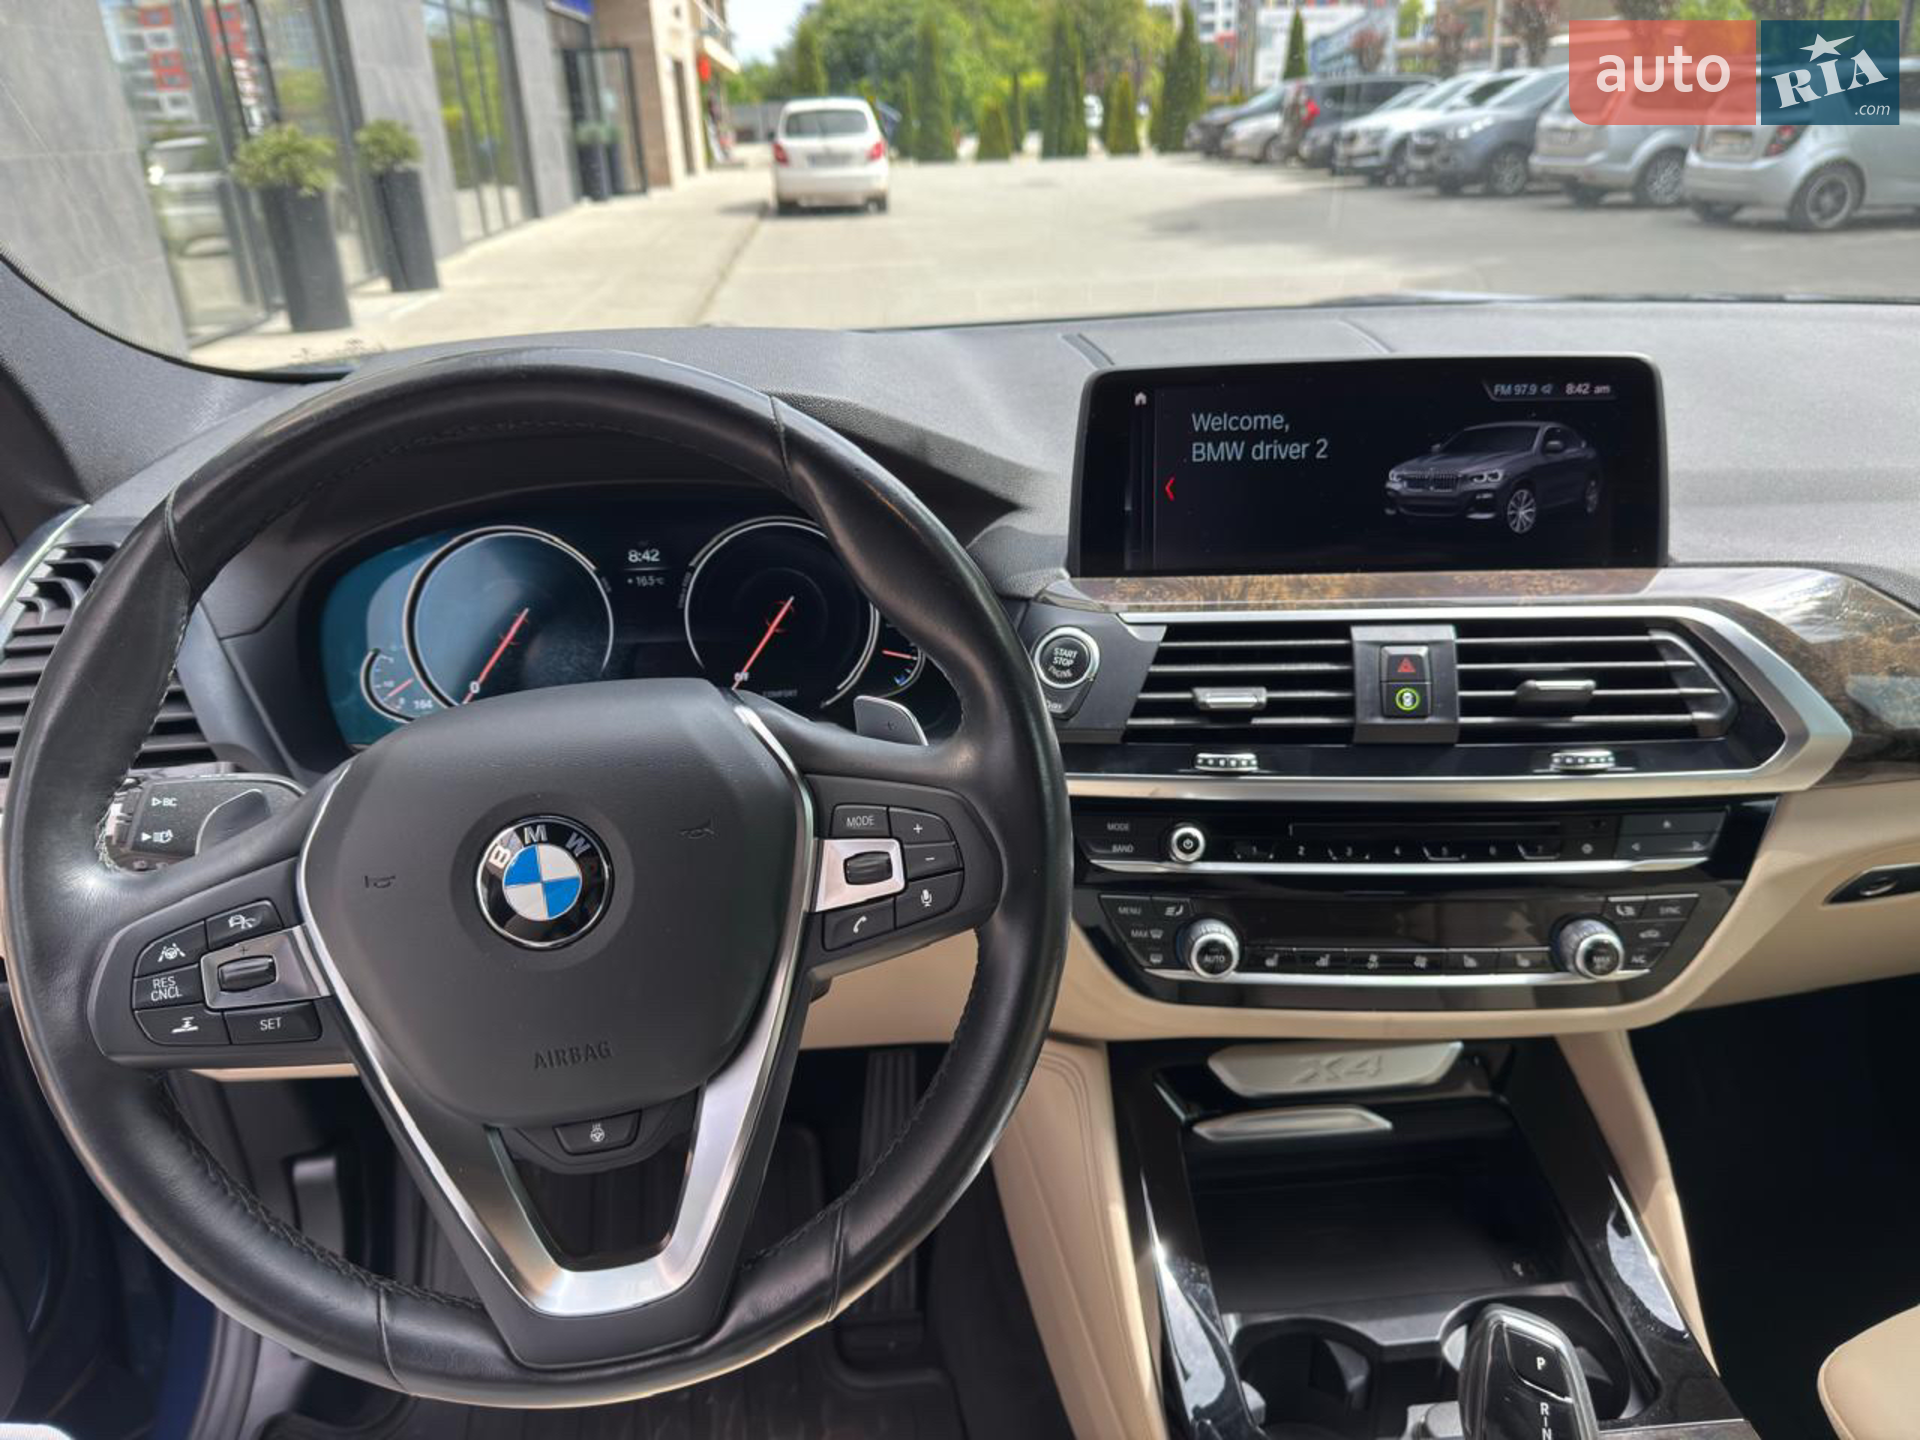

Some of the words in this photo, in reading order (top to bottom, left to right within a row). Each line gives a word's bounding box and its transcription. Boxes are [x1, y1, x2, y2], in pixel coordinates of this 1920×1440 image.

[1493, 383, 1512, 395] FM
[1514, 383, 1537, 395] 97.9
[1566, 382, 1590, 395] 8:42
[1594, 385, 1611, 394] am
[1191, 413, 1290, 432] Welcome,
[1192, 441, 1245, 462] BMW
[1251, 440, 1310, 460] driver
[1315, 438, 1329, 459] 2
[628, 549, 660, 563] 8:42
[1053, 647, 1078, 659] START
[1052, 656, 1075, 667] STOP
[162, 797, 178, 807] BC
[846, 815, 875, 828] MODE
[1106, 822, 1129, 831] MODE
[488, 824, 591, 869] BMW
[1112, 844, 1134, 853] BAND
[1118, 906, 1141, 915] MENU
[1203, 955, 1226, 963] AUTO
[152, 976, 177, 989] RES
[150, 986, 183, 1002] CNCL
[259, 1017, 283, 1031] SET
[534, 1041, 614, 1069] AIRBAG
[1292, 1054, 1383, 1085] X4
[1536, 1356, 1546, 1370] P
